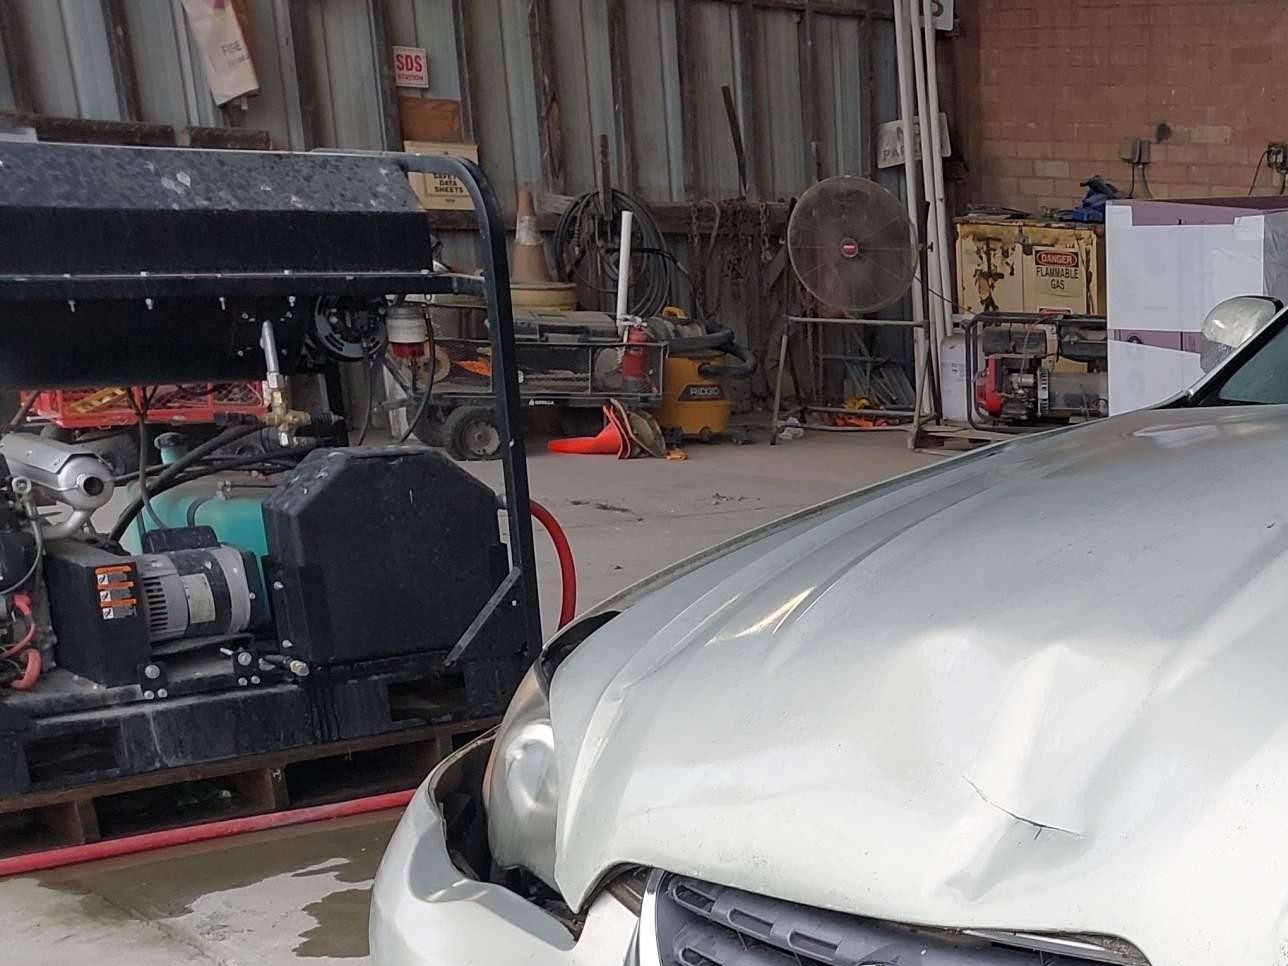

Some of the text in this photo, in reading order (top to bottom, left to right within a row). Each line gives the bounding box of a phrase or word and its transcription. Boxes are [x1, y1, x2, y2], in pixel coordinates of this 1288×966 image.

[396, 54, 423, 72] SDS
[1041, 253, 1073, 265] DANGER
[1036, 266, 1079, 279] FLAMMABLE
[1050, 279, 1065, 290] GAS
